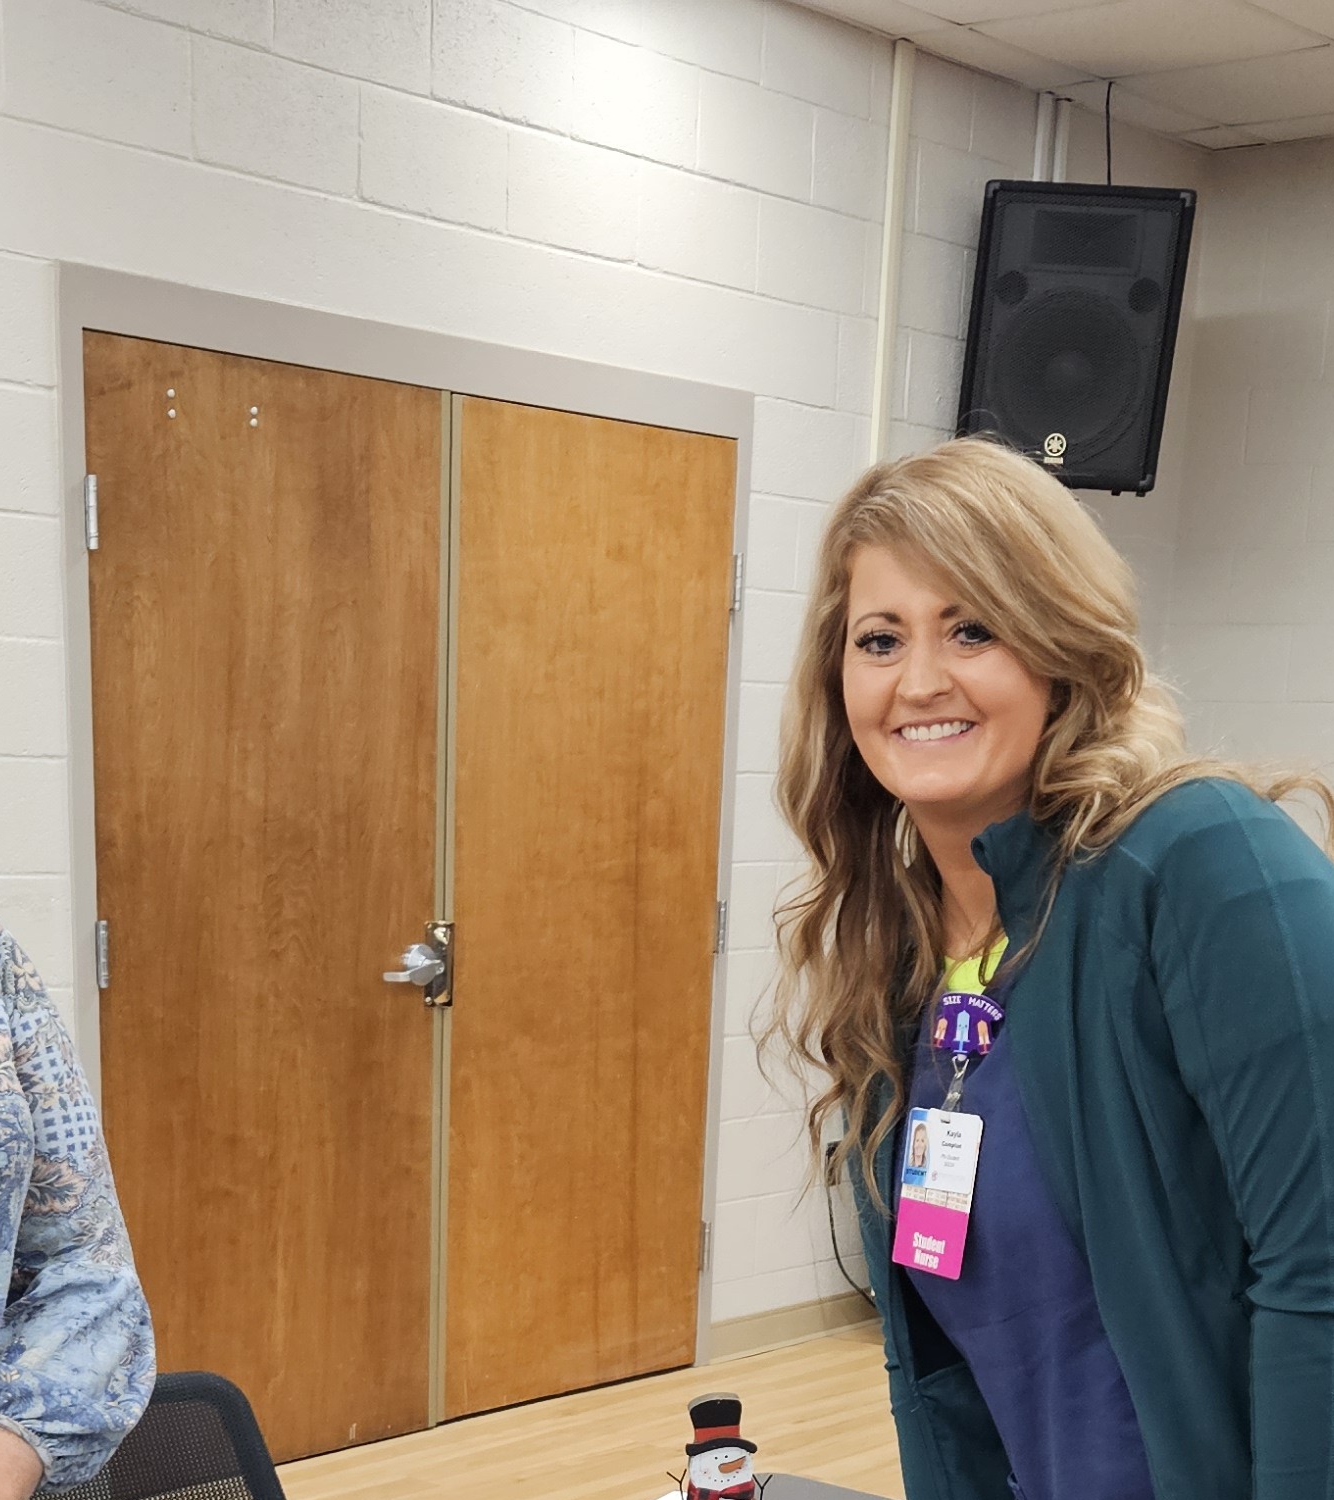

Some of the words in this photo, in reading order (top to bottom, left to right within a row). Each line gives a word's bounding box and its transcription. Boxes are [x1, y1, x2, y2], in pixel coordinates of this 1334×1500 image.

[943, 996, 961, 1005] SIZE
[968, 997, 1003, 1020] MATTERS
[913, 1232, 946, 1254] Student
[913, 1249, 940, 1269] Nurse
